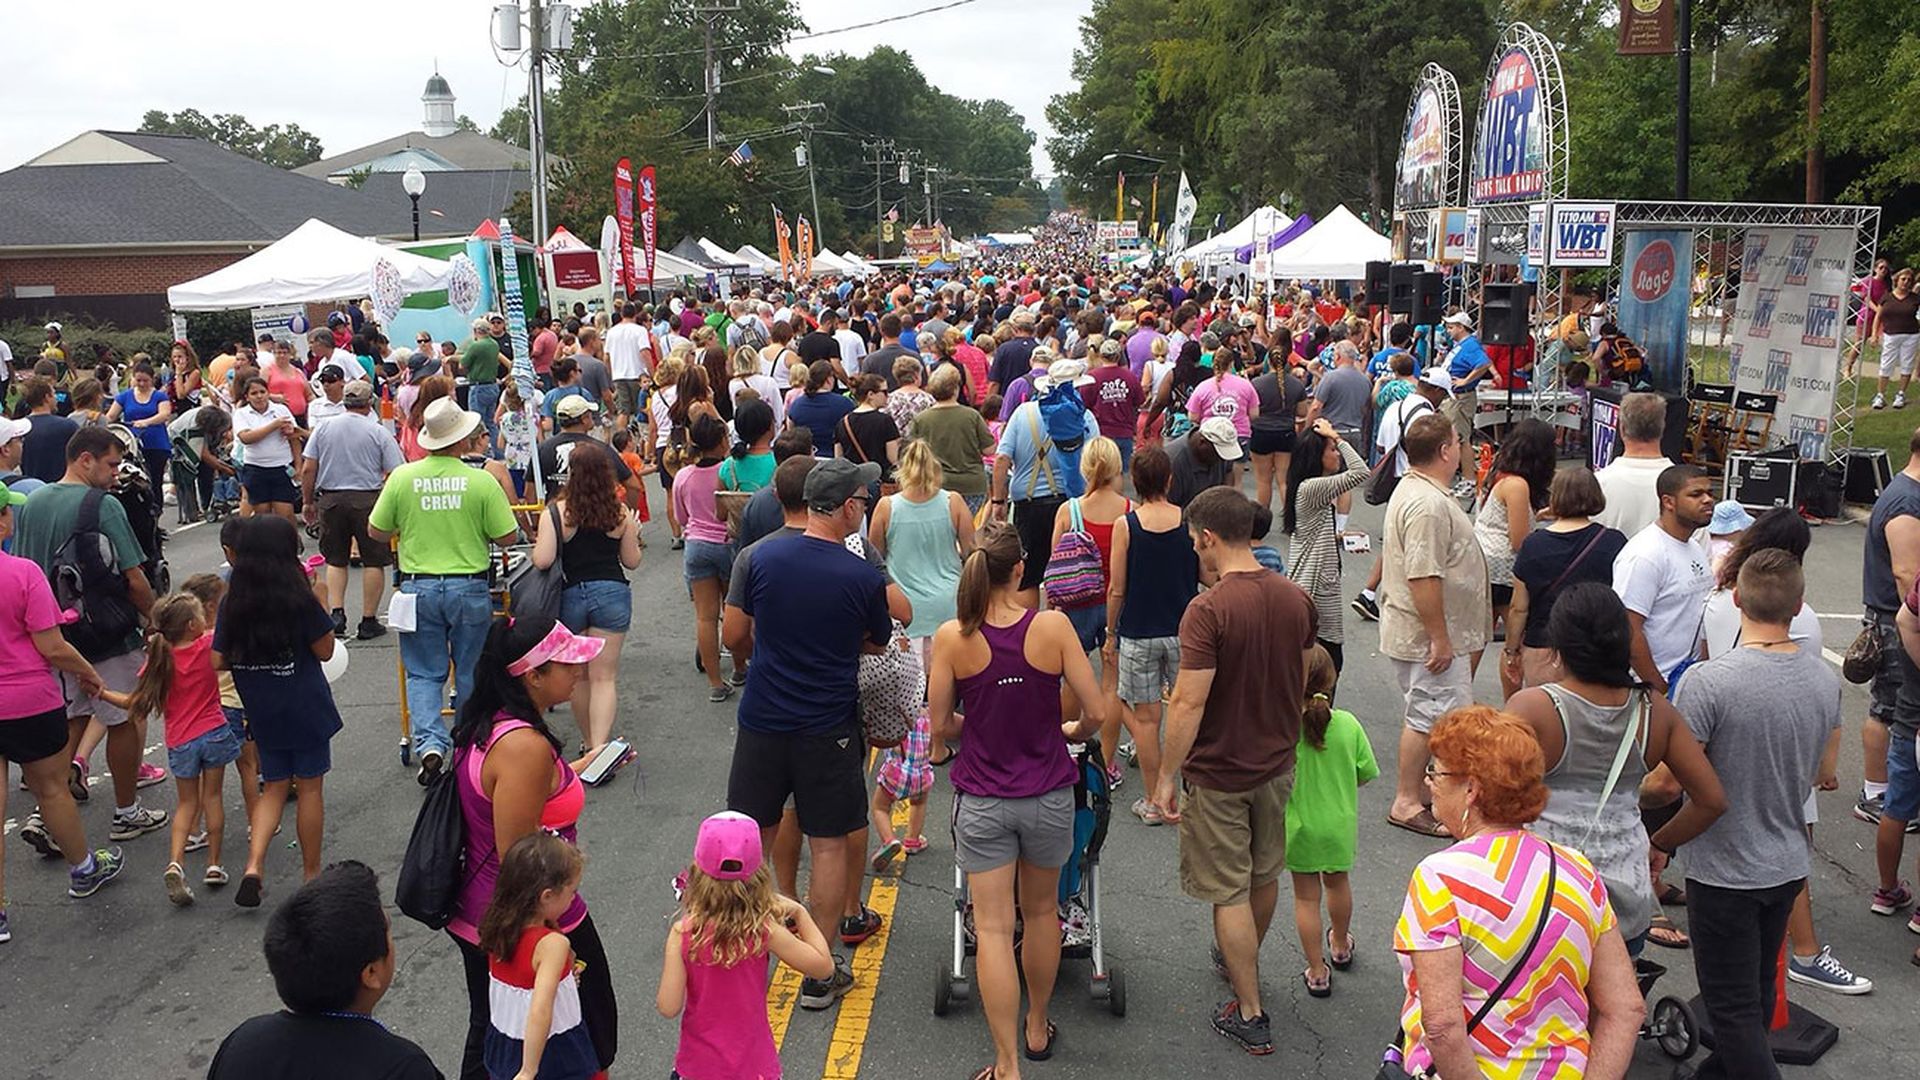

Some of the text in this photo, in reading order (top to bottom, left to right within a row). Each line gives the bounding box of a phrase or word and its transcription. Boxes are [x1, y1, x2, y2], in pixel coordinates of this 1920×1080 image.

[1485, 87, 1535, 179] WBT
[1516, 171, 1542, 193] RADIO
[1560, 224, 1606, 249] WBT
[1806, 306, 1838, 338] WBT
[1102, 379, 1127, 390] 2014
[413, 476, 468, 493] PARADE
[420, 494, 462, 511] CREW
